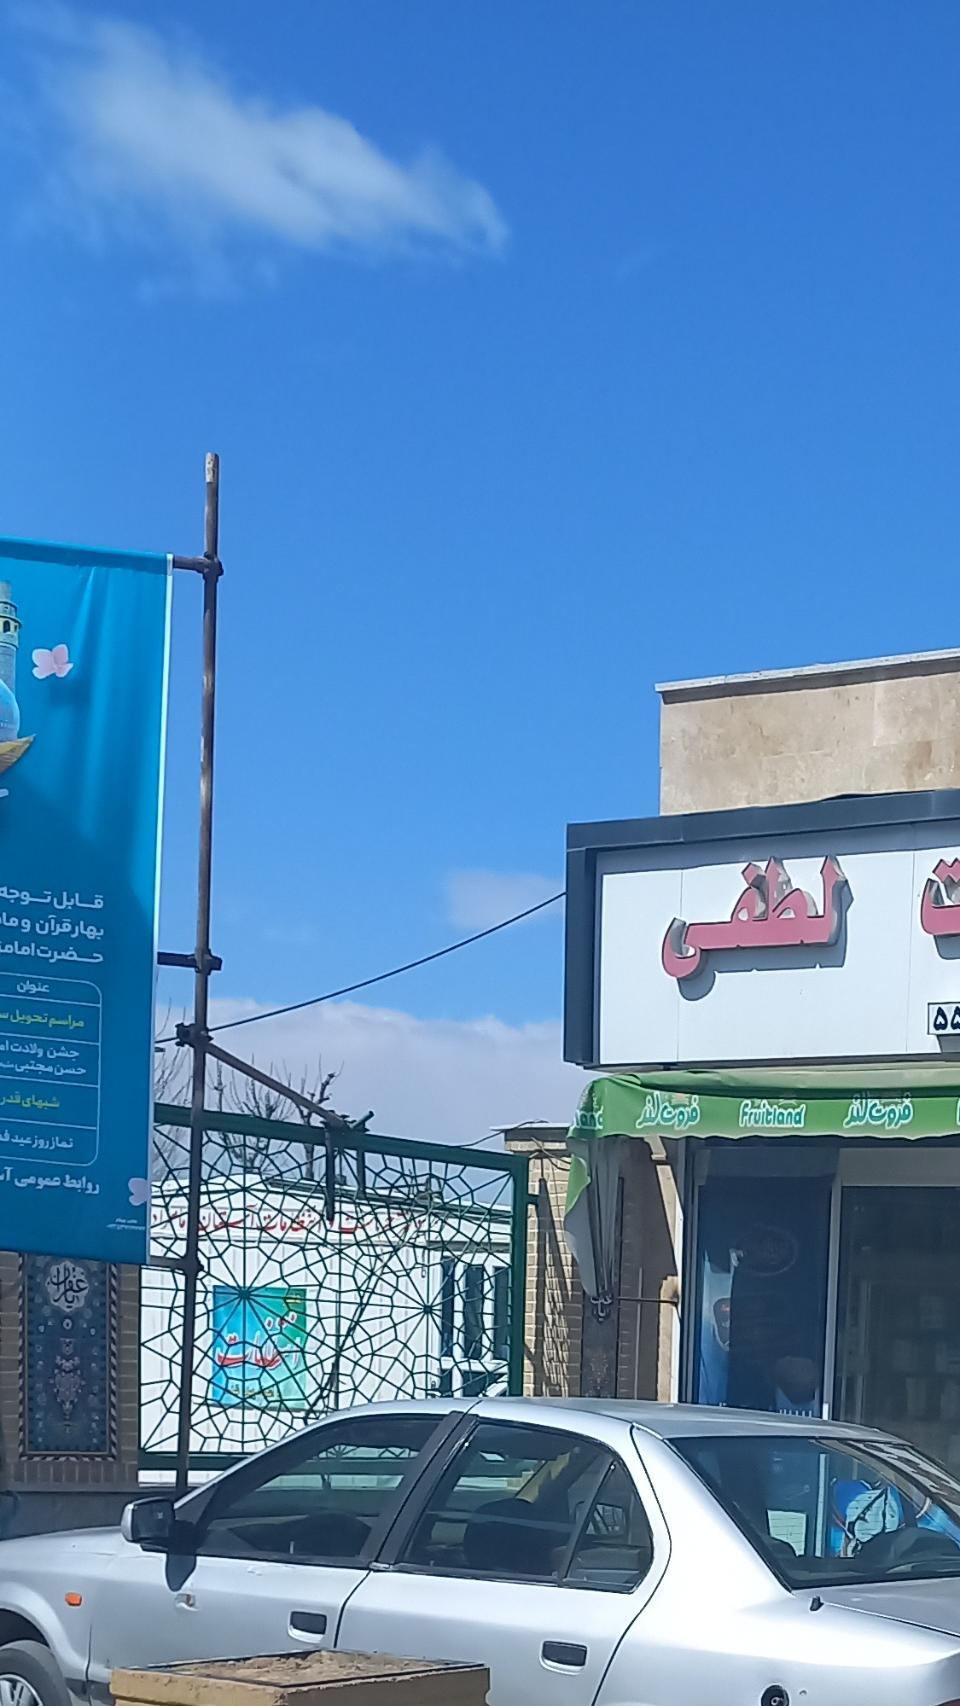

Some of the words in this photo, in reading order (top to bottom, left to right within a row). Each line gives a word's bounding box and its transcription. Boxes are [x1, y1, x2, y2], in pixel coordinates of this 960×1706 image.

[0, 912, 19, 928] ما
[36, 915, 72, 936] قرآن
[662, 854, 850, 982] لطفی
[70, 920, 104, 939] بهار
[37, 946, 104, 964] حضرت
[16, 980, 50, 994] عنوان
[46, 1045, 80, 1061] جشن
[54, 1064, 87, 1076] حسن
[738, 1101, 806, 1128] Fruitland
[14, 1175, 62, 1191] عمومی
[62, 1173, 100, 1195] روابط
